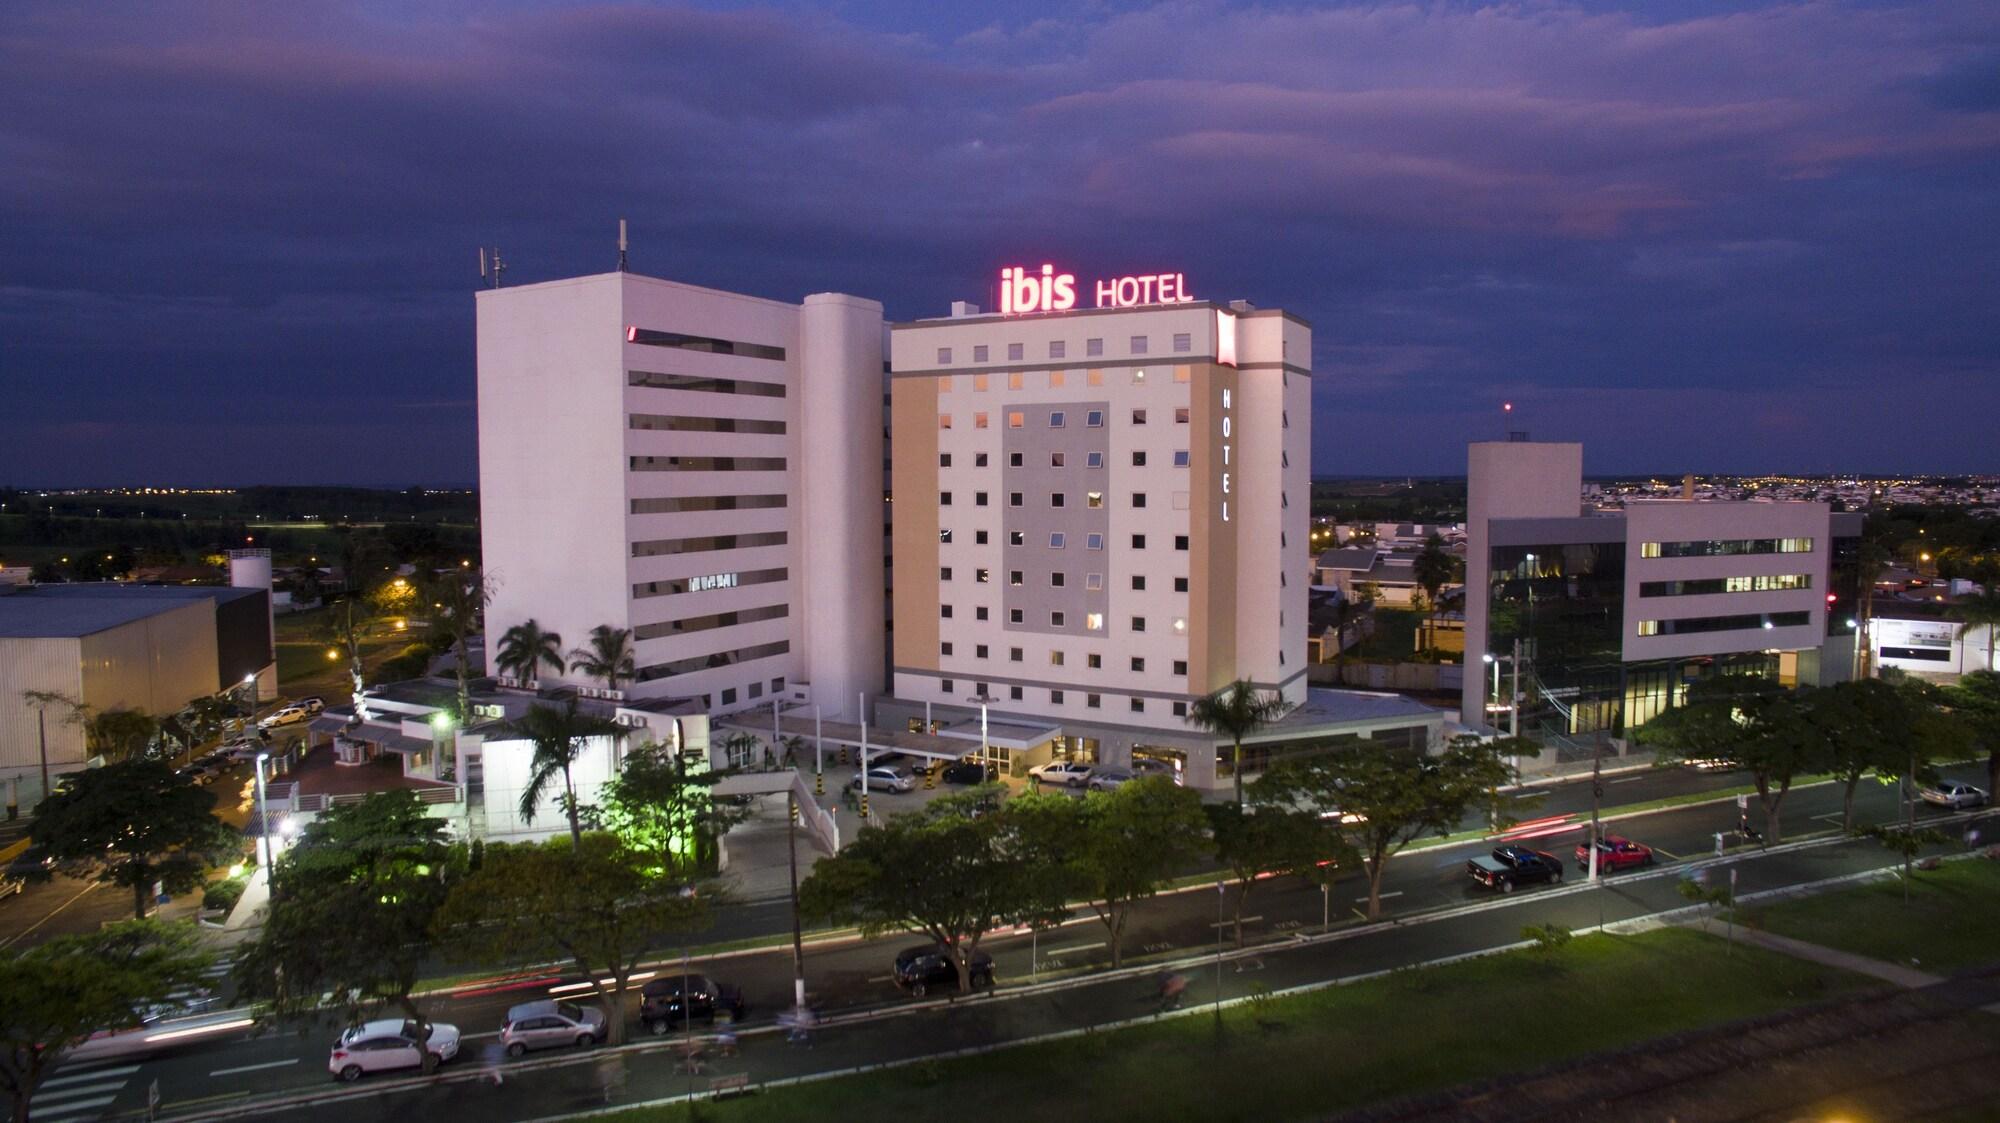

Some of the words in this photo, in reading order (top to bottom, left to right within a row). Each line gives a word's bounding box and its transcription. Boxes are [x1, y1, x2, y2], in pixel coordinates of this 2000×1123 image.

[1001, 264, 1076, 314] ibis
[1096, 273, 1194, 307] HOTEL
[1222, 388, 1231, 522] HOTEL
